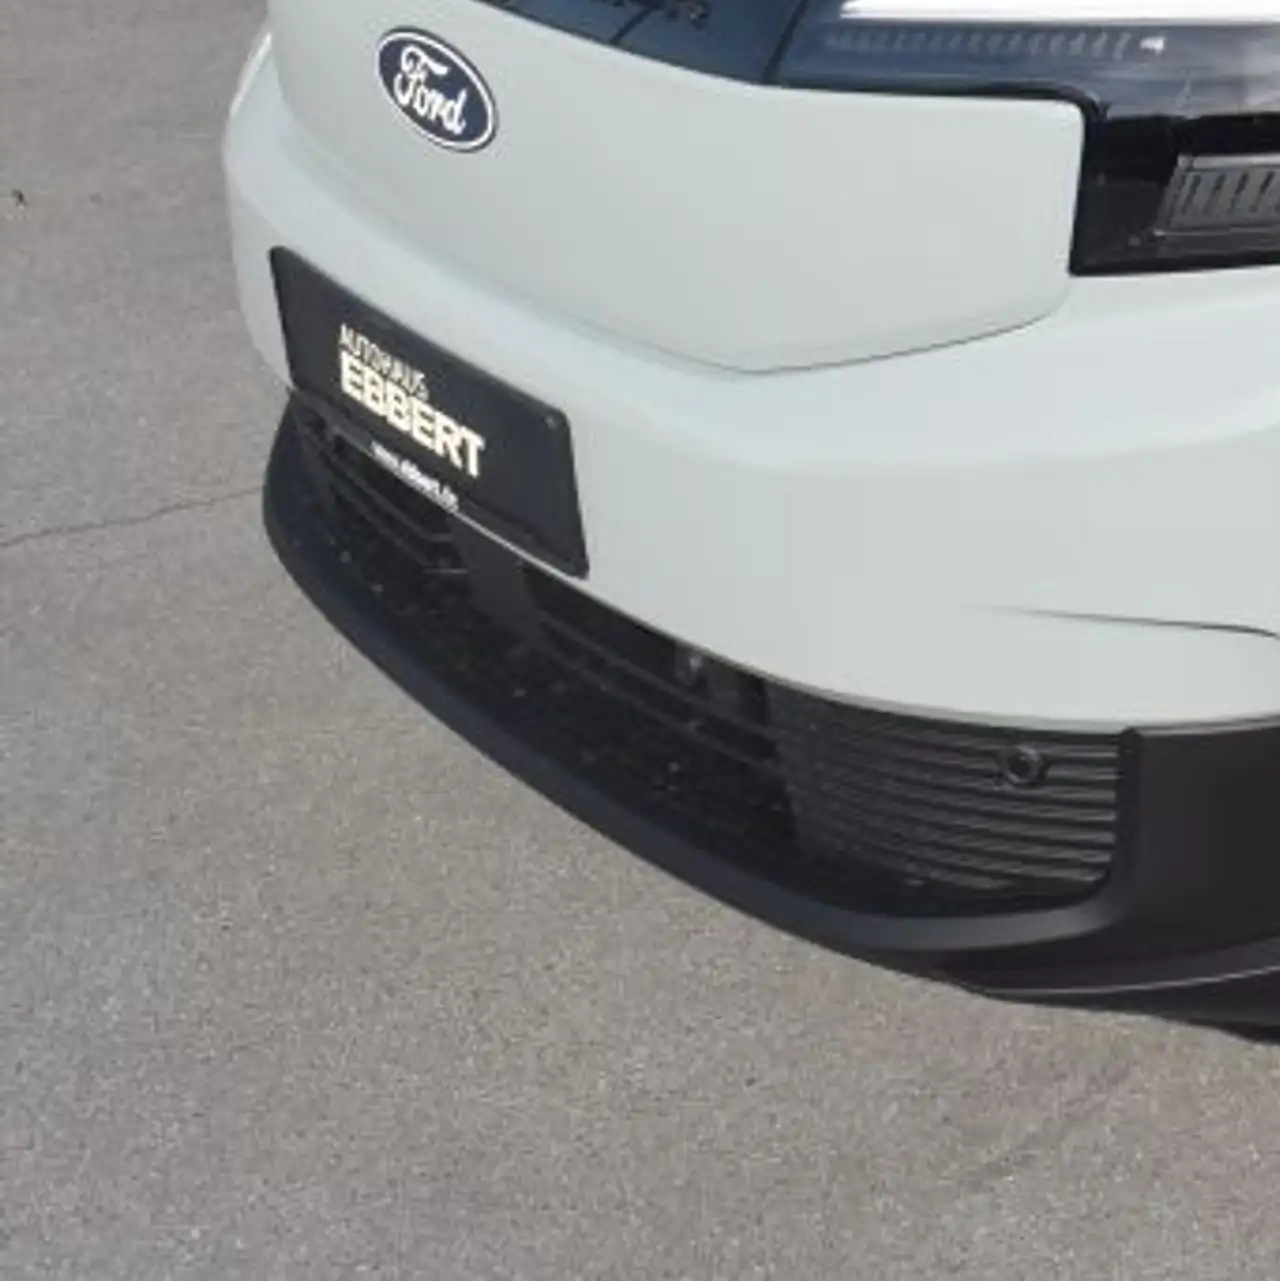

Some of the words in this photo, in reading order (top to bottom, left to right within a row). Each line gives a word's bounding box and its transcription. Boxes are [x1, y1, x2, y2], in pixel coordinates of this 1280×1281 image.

[394, 45, 467, 135] Ford
[339, 323, 429, 402] AUTOHAUS
[340, 351, 486, 479] EBBERT
